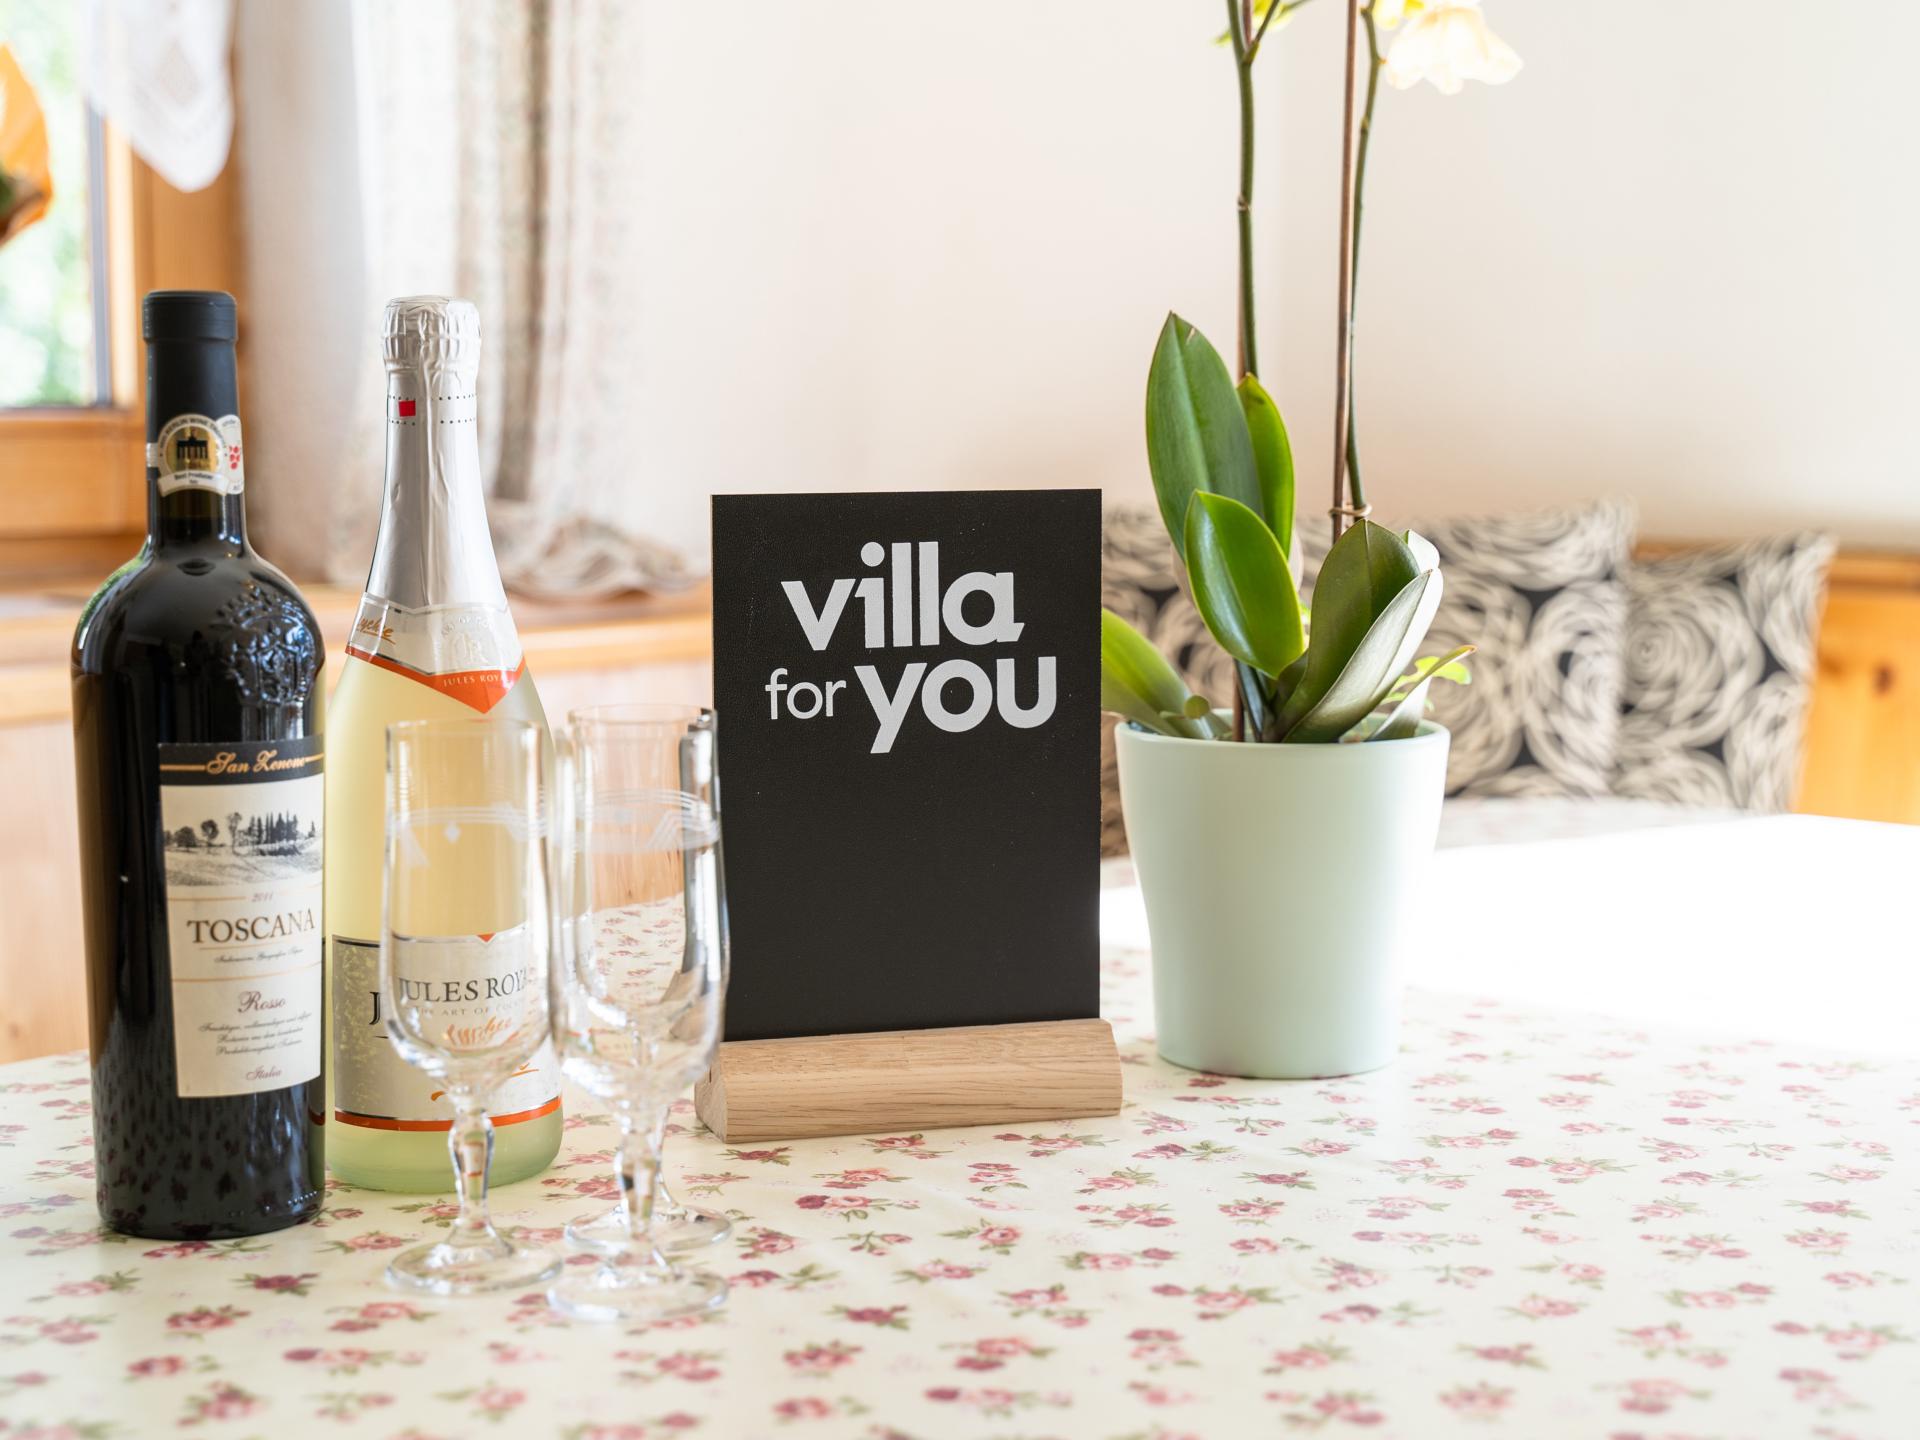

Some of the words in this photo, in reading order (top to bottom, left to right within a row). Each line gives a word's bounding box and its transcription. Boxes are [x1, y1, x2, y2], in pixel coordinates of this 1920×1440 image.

[780, 541, 1025, 651] villa
[443, 676, 476, 687] JULES
[764, 667, 847, 720] for
[853, 655, 1057, 754] you
[206, 752, 250, 775] San
[186, 907, 316, 944] TOSCANA
[237, 990, 287, 1014] Rosso
